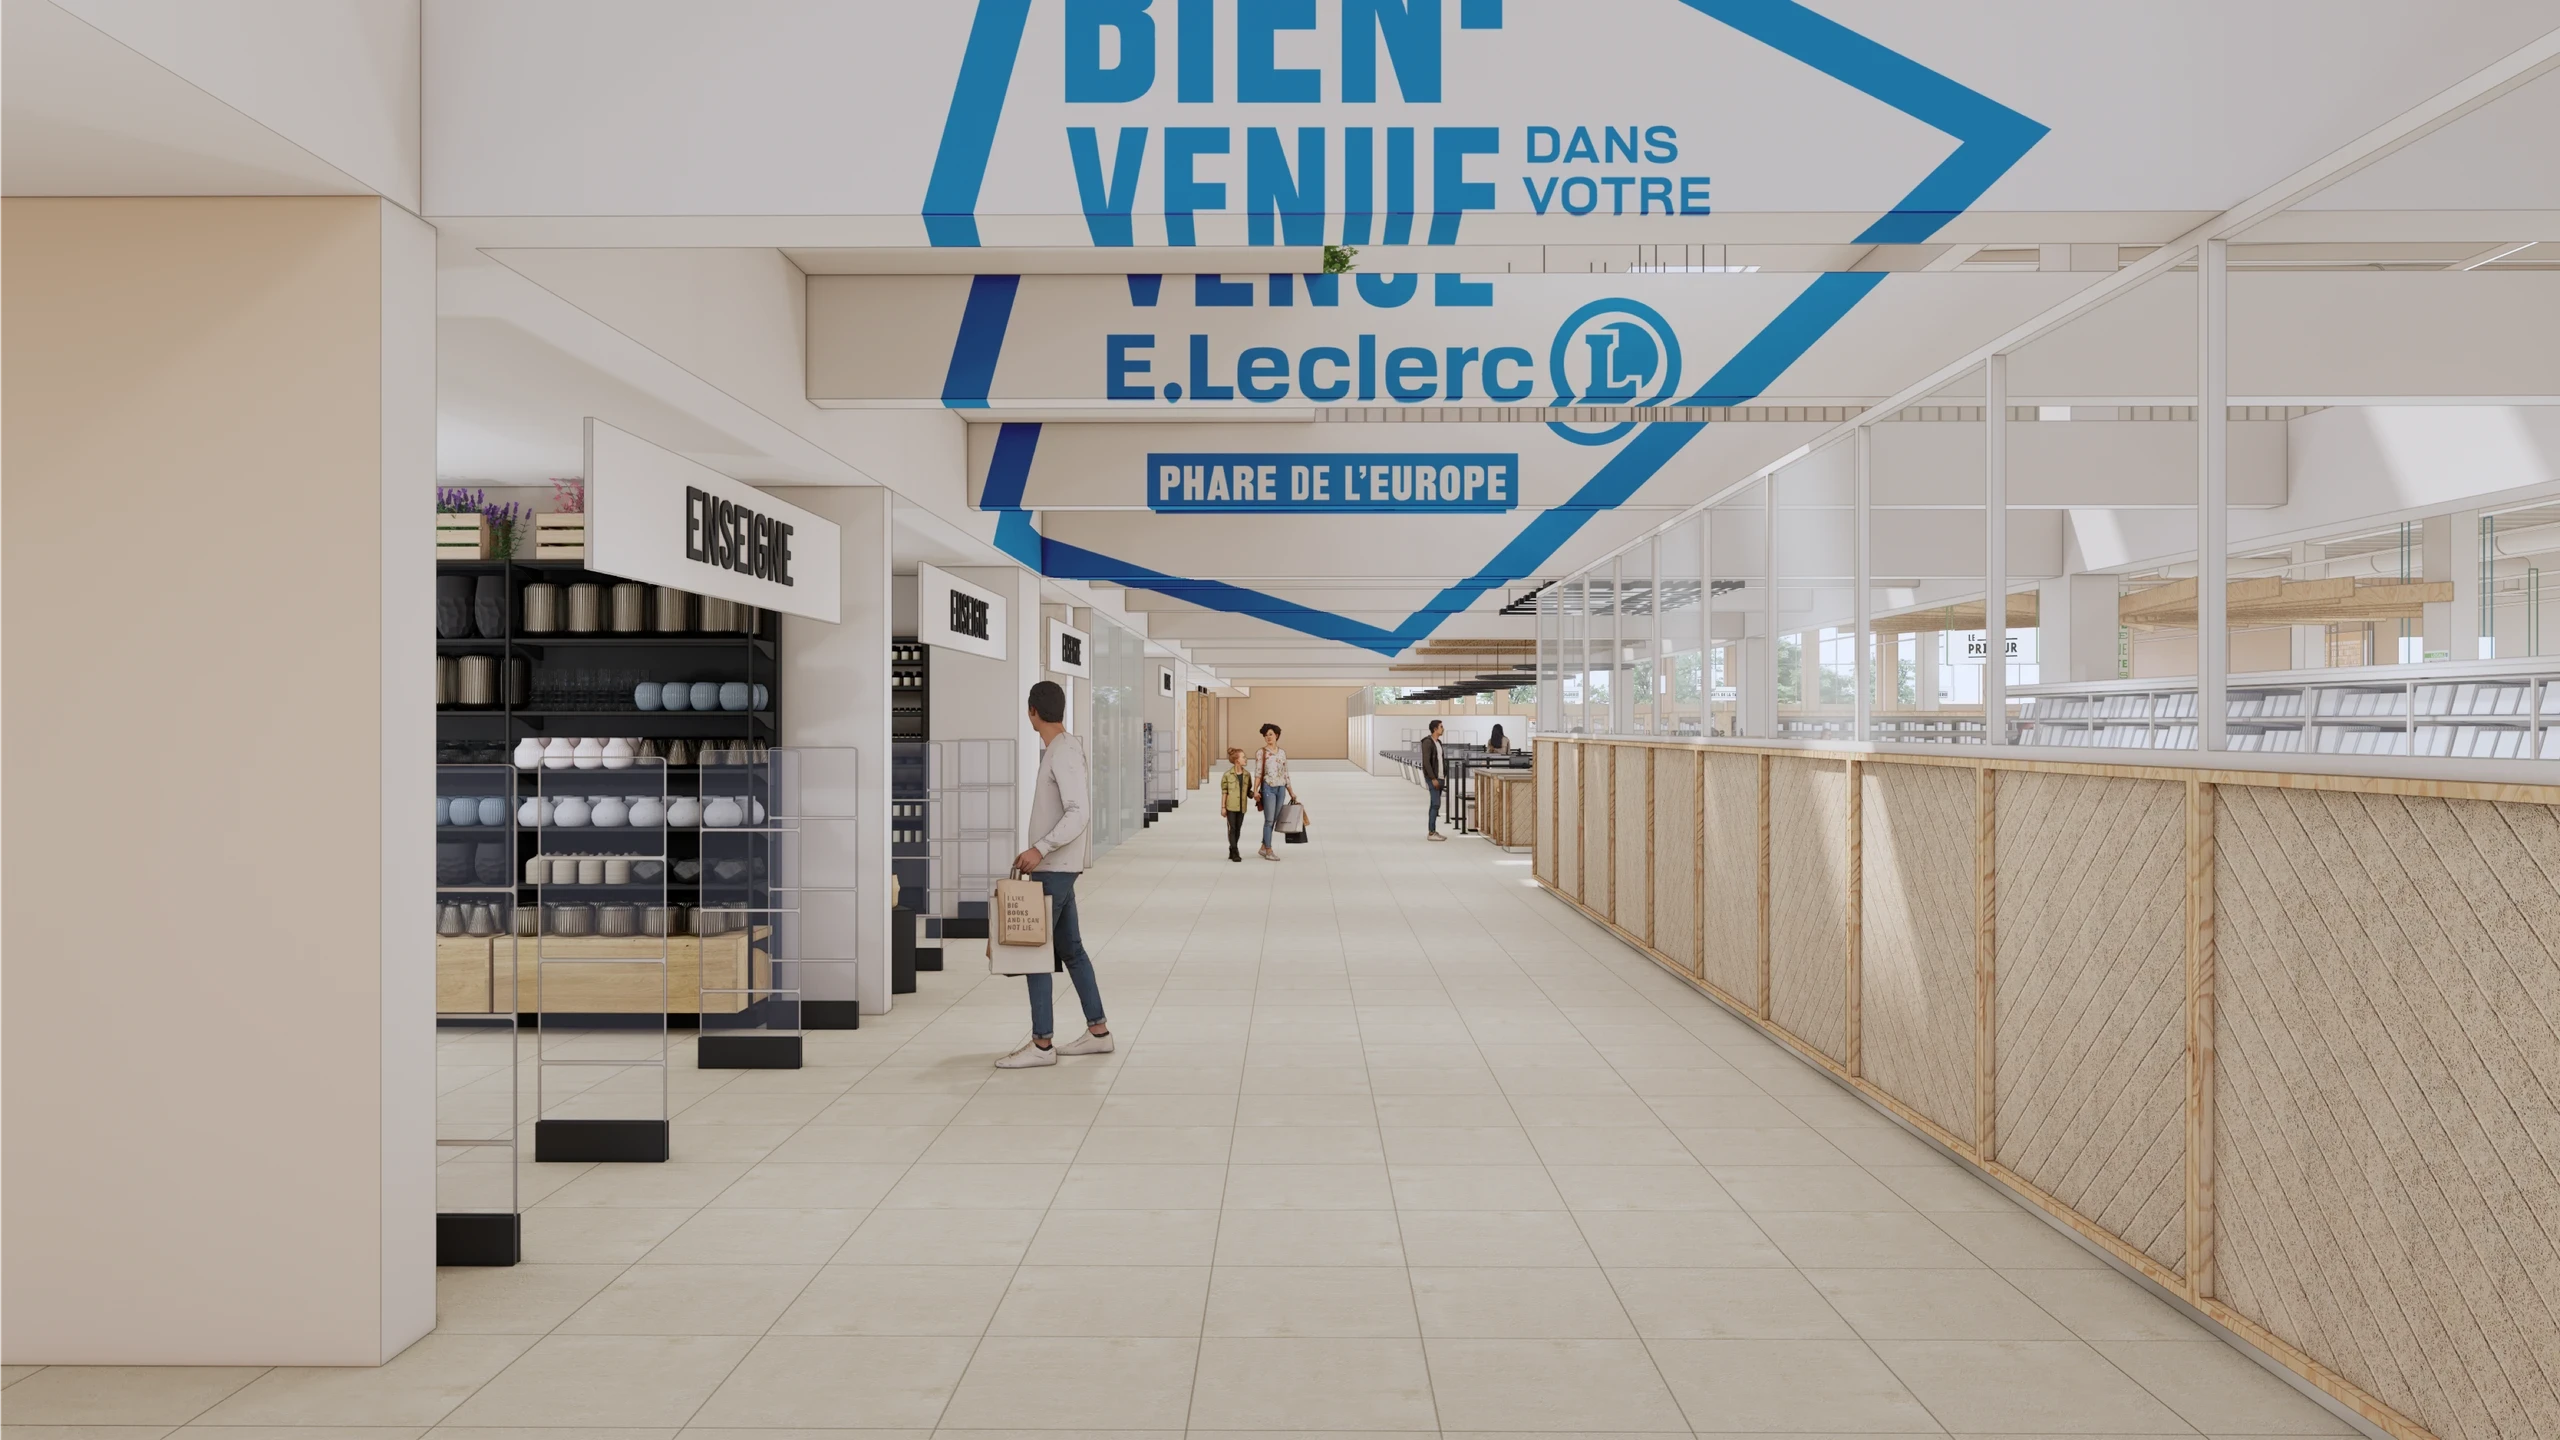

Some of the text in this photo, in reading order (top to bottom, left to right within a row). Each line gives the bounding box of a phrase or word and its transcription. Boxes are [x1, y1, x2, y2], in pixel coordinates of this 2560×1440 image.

[1526, 126, 1678, 164] DANS
[1523, 176, 1711, 216] VOTRE
[1106, 333, 1535, 404] E.Leclerc
[1159, 465, 1507, 501] PHARE DE L'EUROPE
[686, 485, 794, 587] ENSEIGNE
[950, 589, 989, 641] ENSEIGNE
